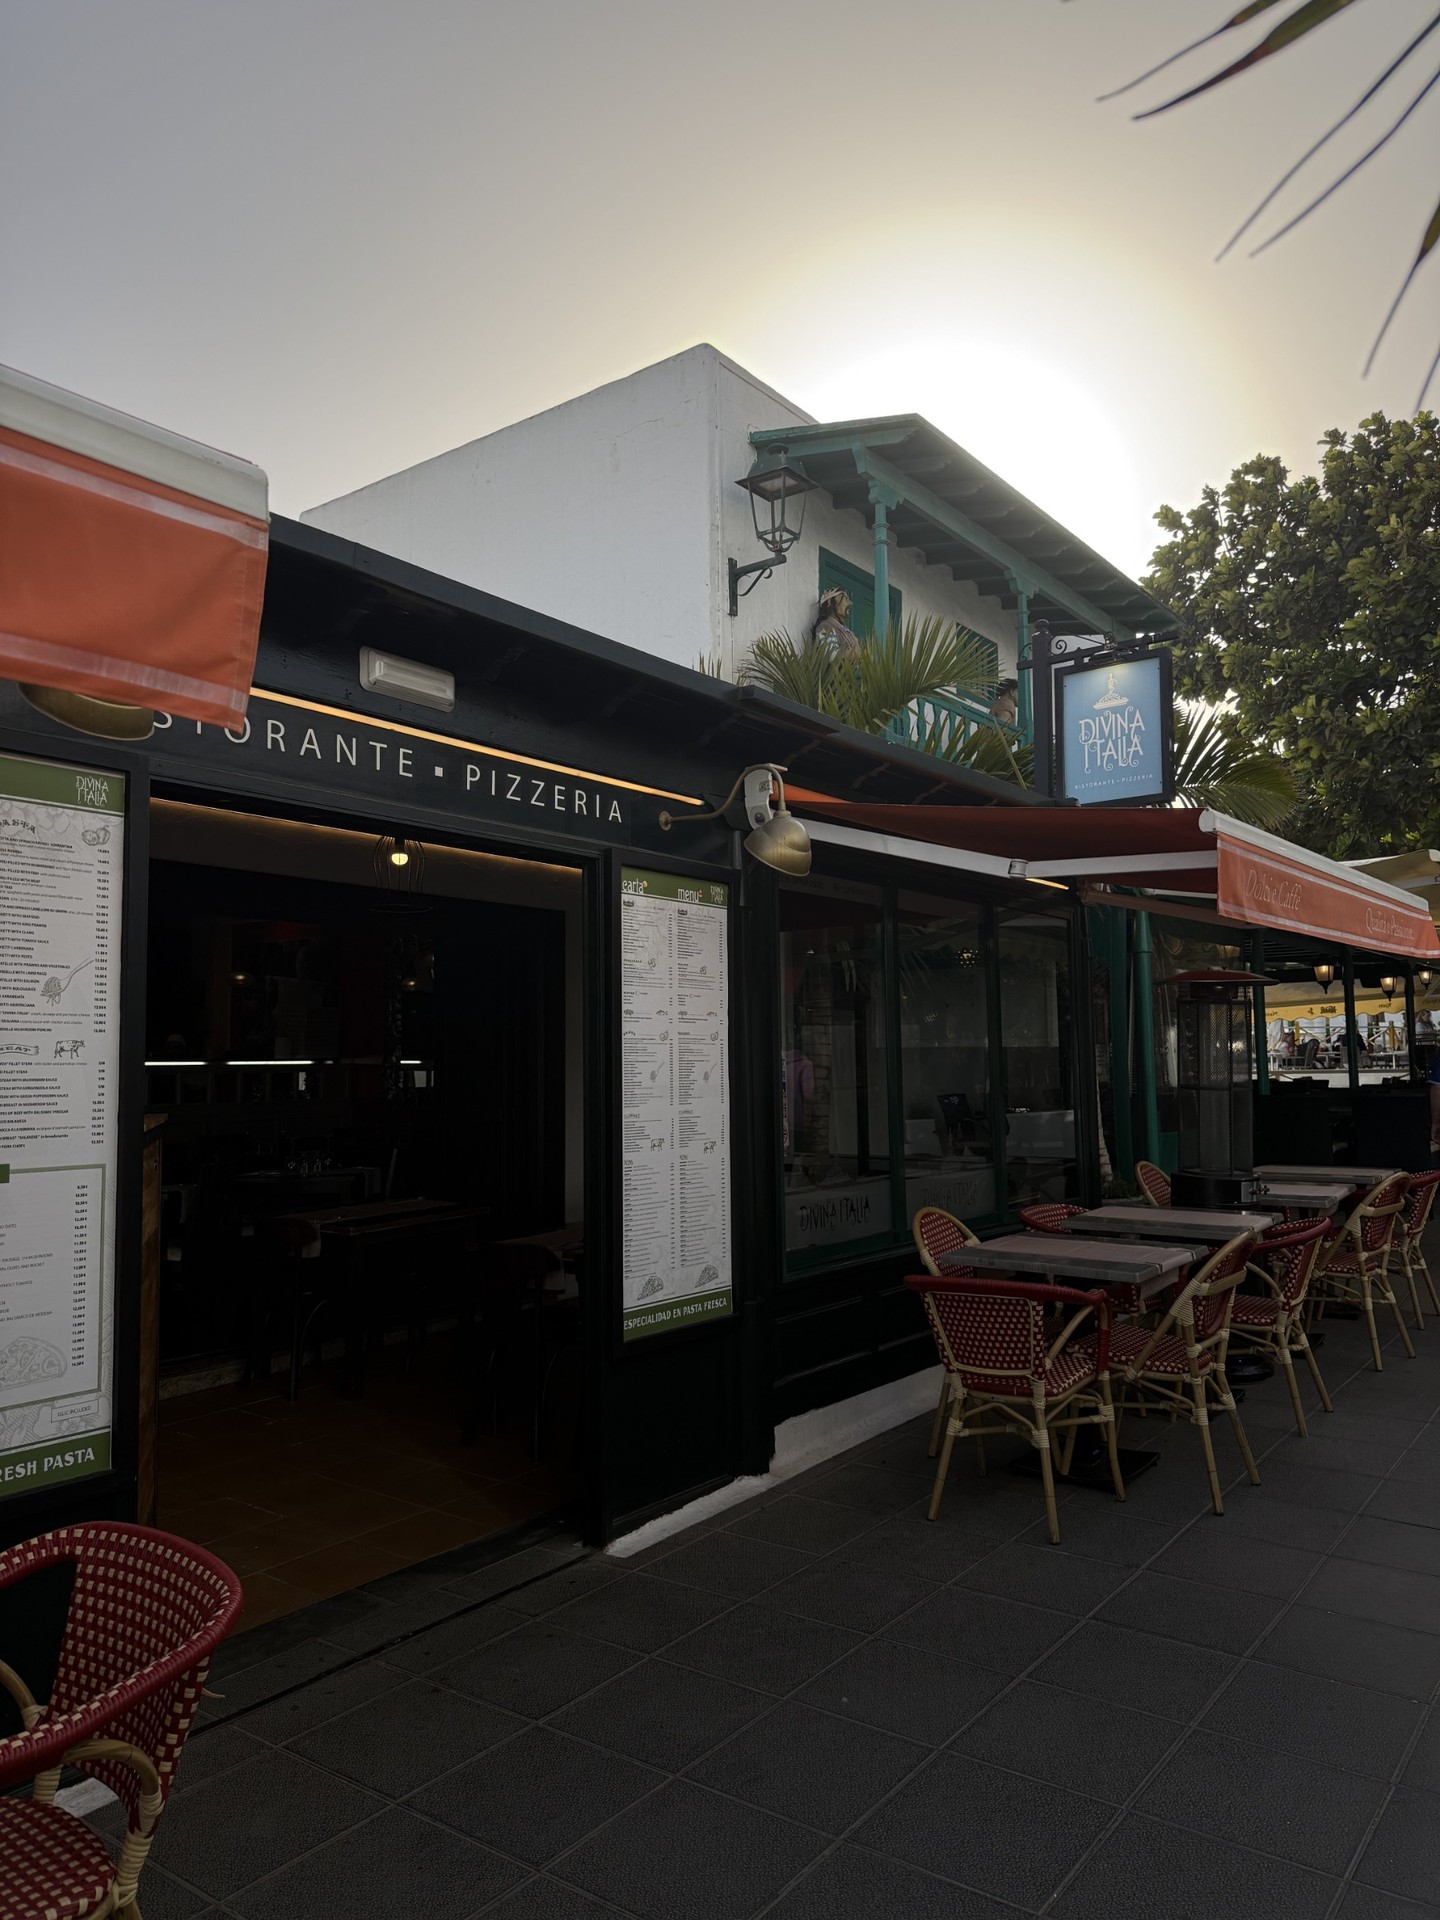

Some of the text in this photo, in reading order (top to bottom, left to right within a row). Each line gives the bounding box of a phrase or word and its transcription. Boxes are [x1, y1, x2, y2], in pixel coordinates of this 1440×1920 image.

[1079, 706, 1146, 744] DIVINA
[1084, 735, 1144, 774] ITALIA
[76, 776, 108, 792] DIVINA
[466, 764, 622, 822] PIZZERIA
[1075, 774, 1152, 790] RISTORANTE PIZZERIA
[78, 788, 108, 808] ITALIA
[0, 819, 36, 834] ASTA
[800, 1194, 871, 1232] DIVINA ITALIA
[623, 1297, 727, 1330] ESPECIALIDAD EN PASTA FRESCA
[43, 1447, 95, 1472] PASTA
